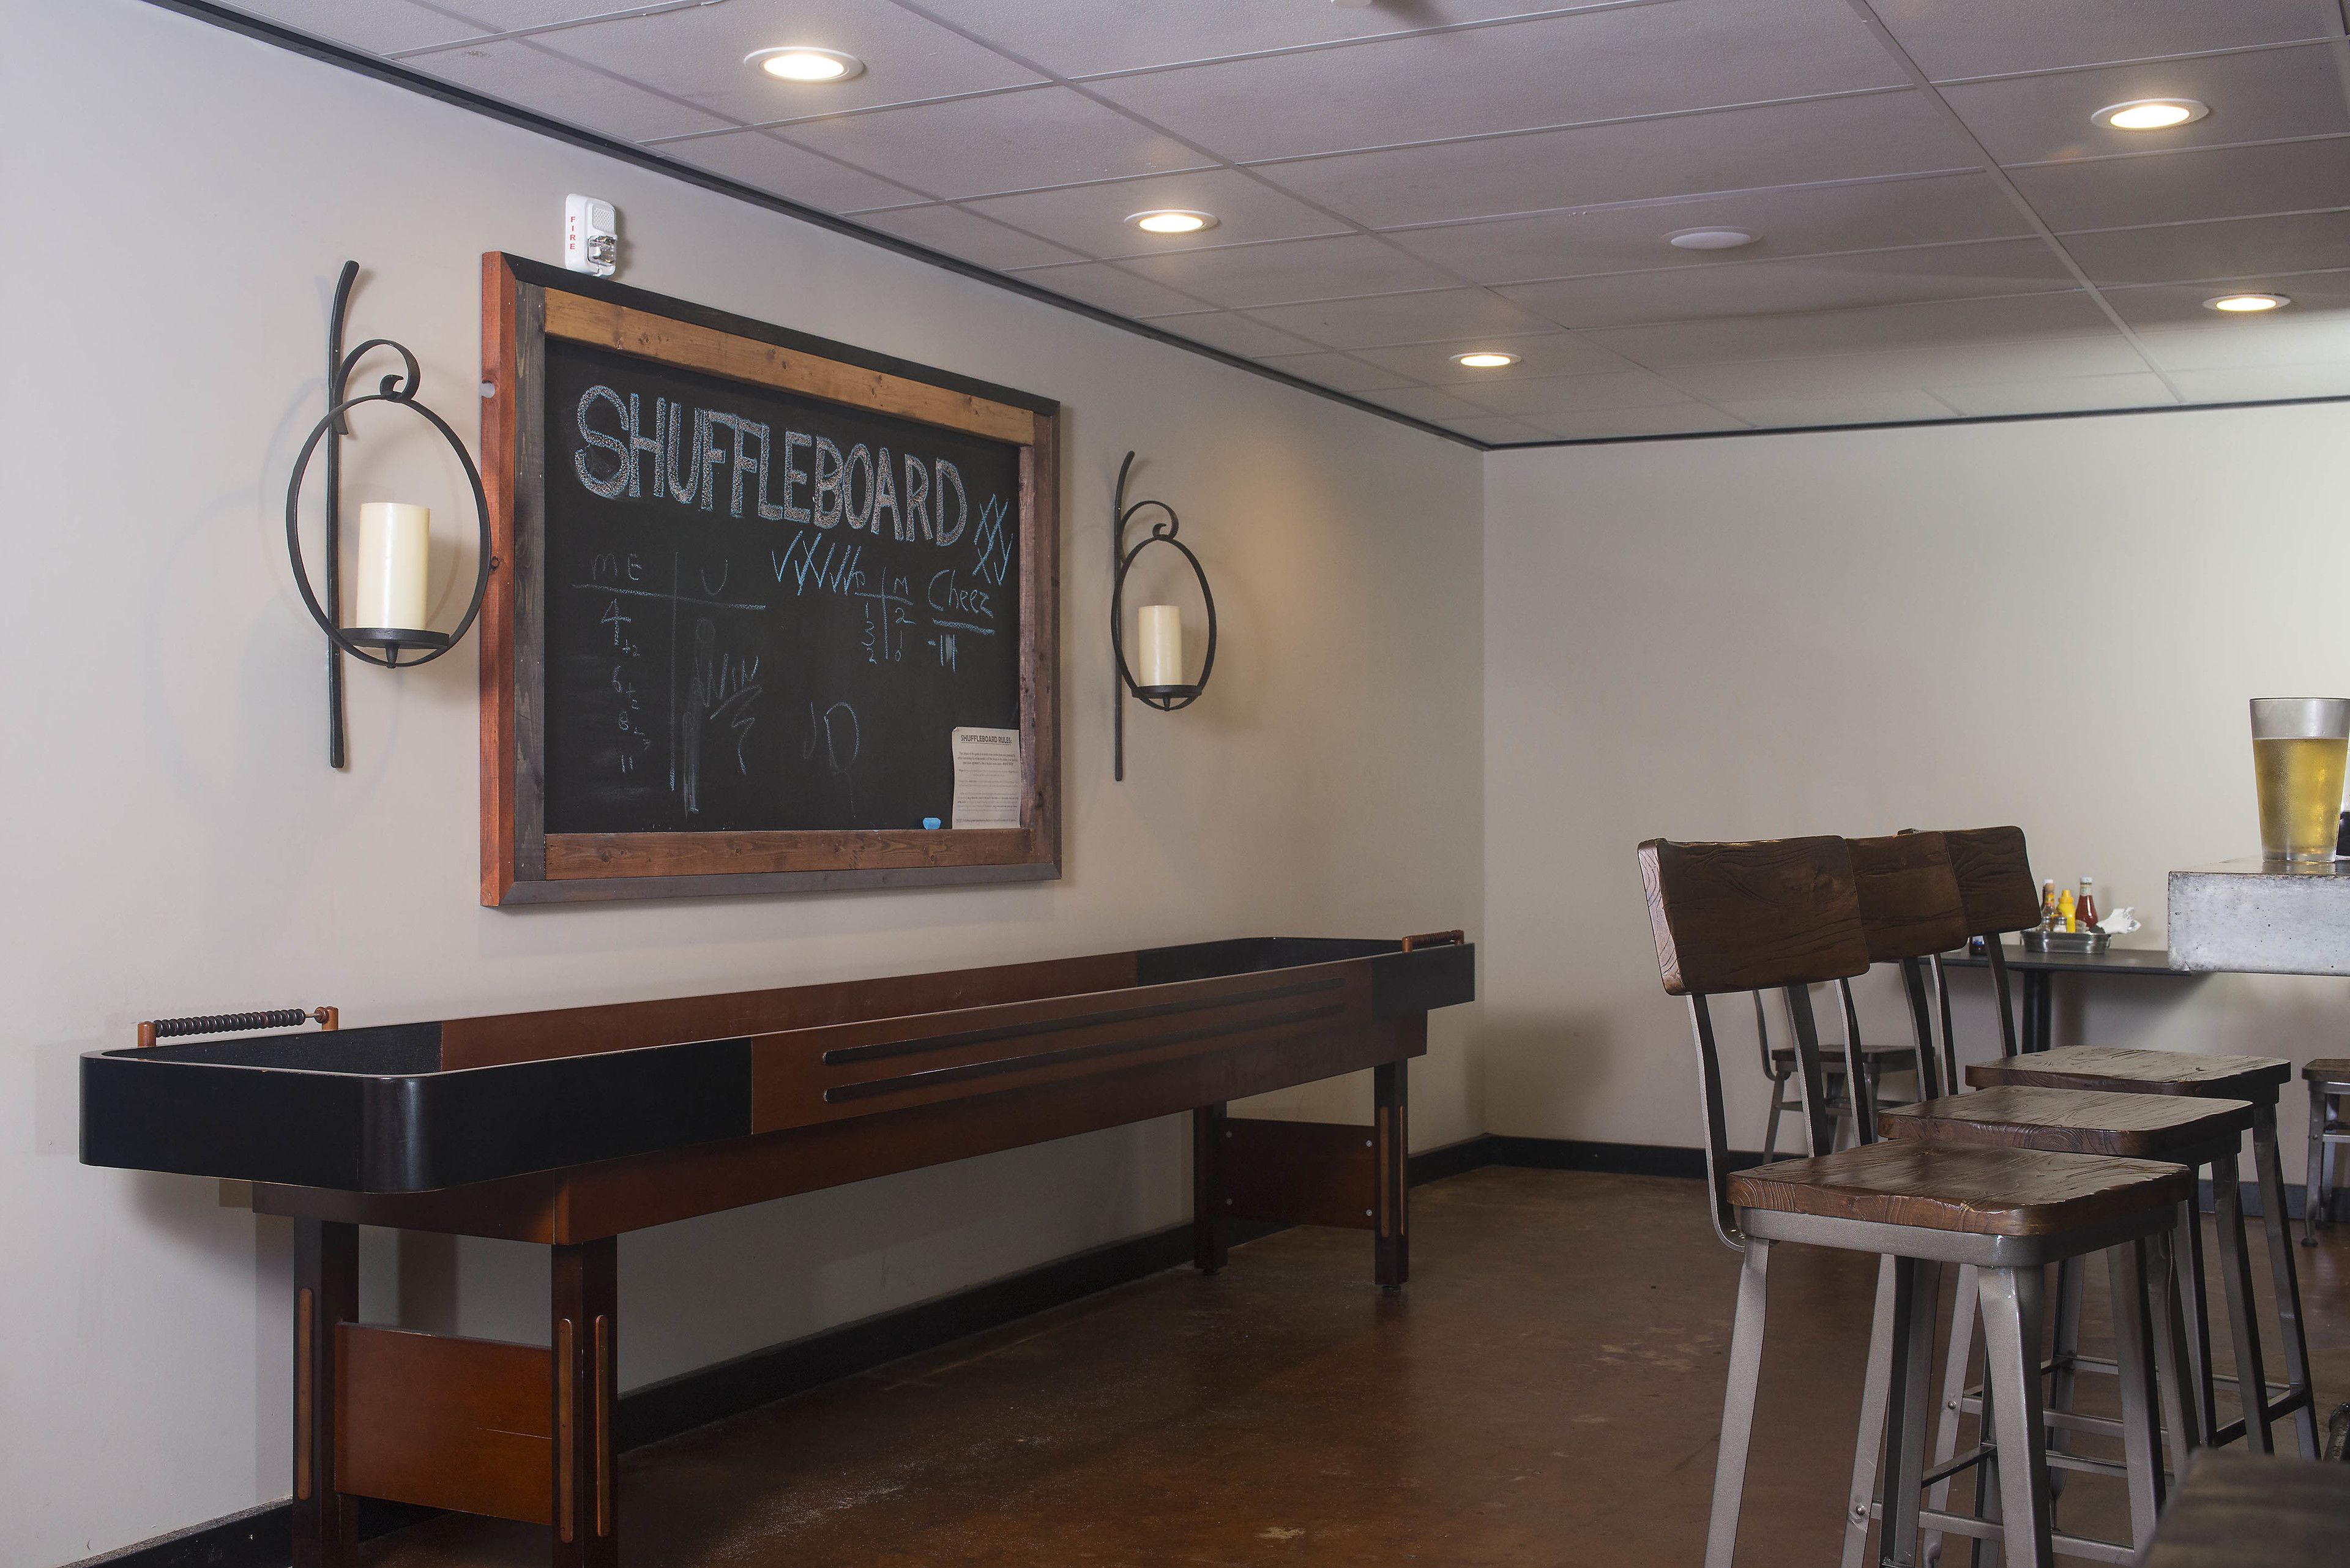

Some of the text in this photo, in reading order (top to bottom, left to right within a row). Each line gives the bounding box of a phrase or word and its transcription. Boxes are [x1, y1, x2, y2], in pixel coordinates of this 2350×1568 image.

[573, 384, 968, 547] SHUFFLEBOARD
[592, 552, 643, 581] ME
[961, 734, 998, 743] SHUFFLEBOARD
